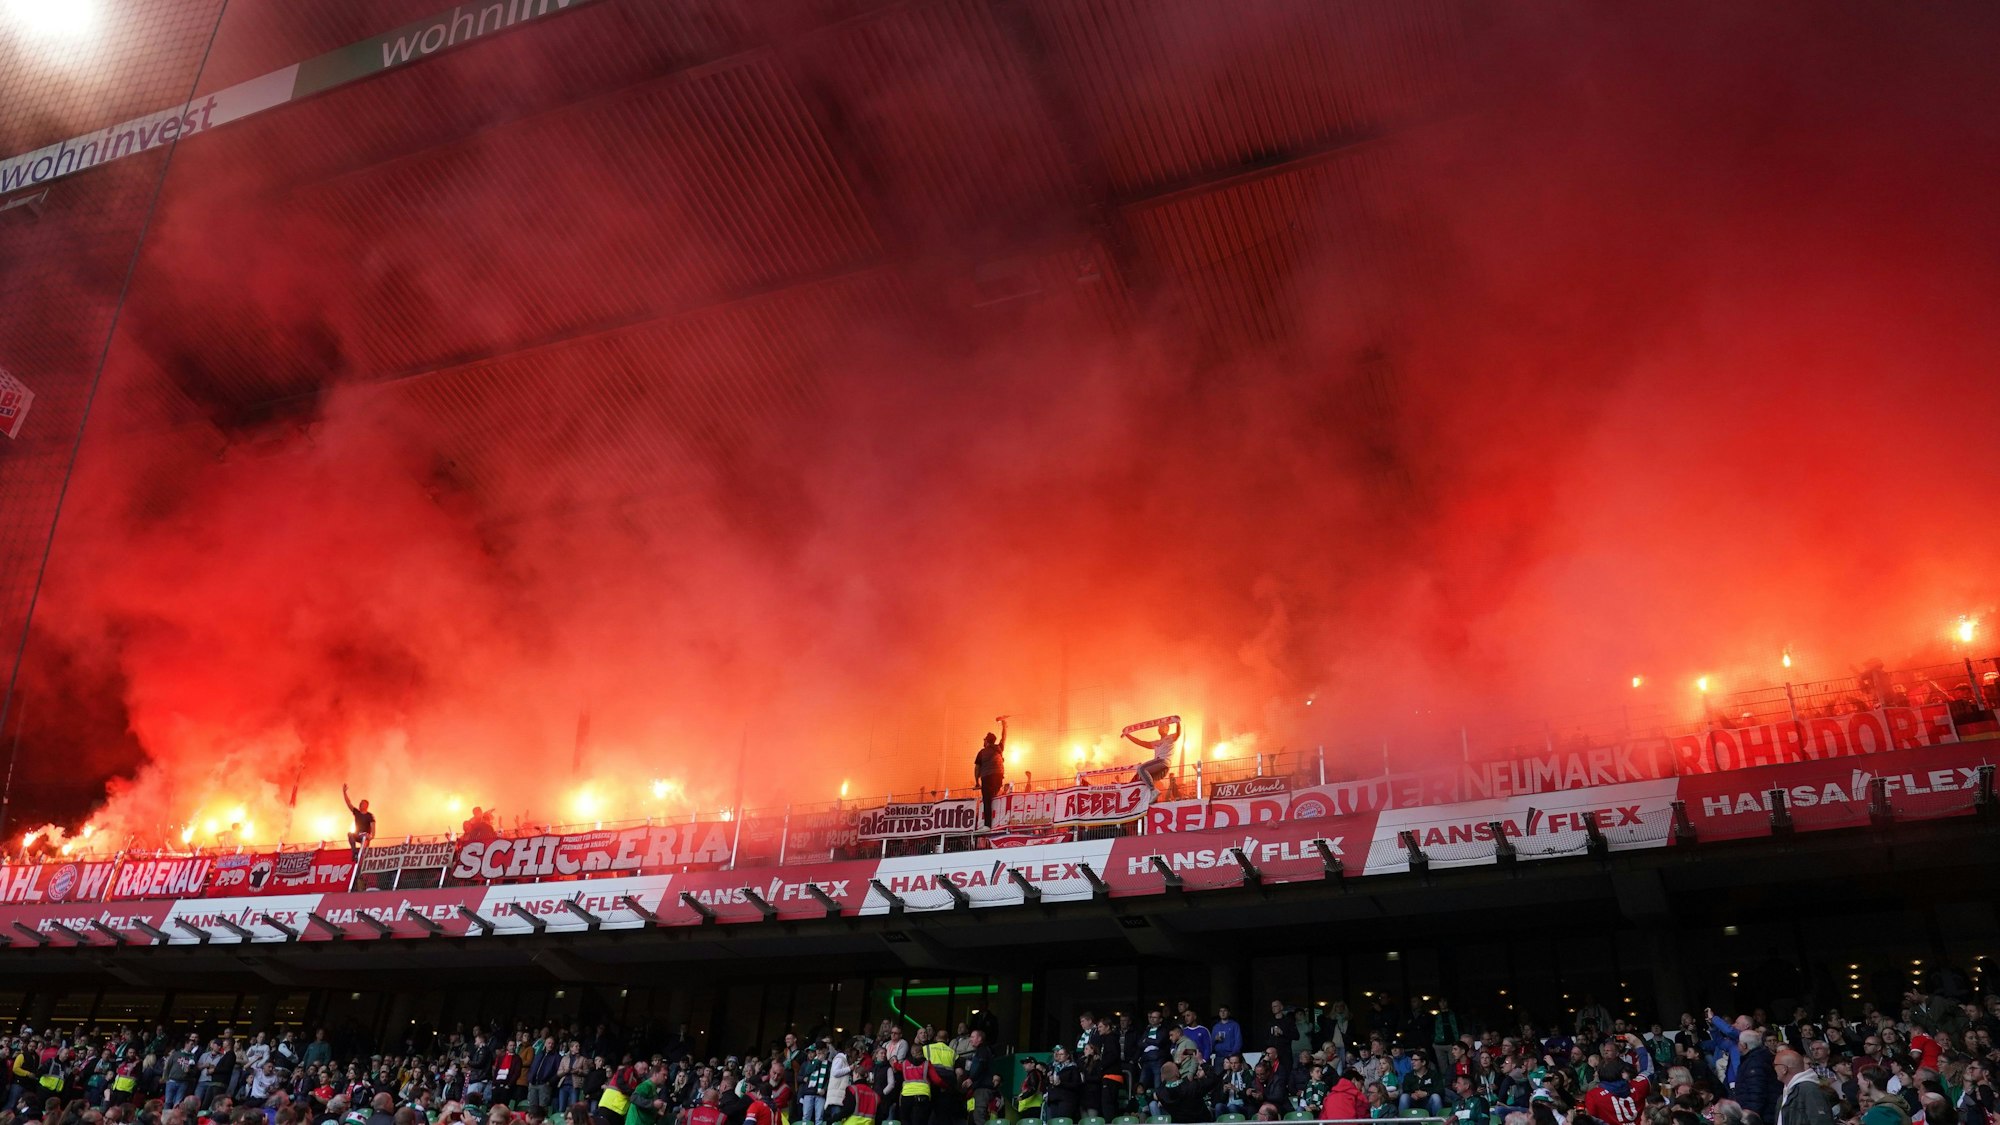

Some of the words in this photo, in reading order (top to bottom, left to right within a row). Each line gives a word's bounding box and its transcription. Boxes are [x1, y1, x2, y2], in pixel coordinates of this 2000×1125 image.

[1, 96, 218, 192] wohninvest
[1673, 704, 1954, 776] ROHRDORF
[1244, 779, 1285, 795] Casuals
[1463, 744, 1666, 798] NEUMARKT
[884, 805, 919, 816] Sektion
[921, 804, 934, 815] SV
[1064, 787, 1142, 818] REBELS
[1147, 802, 1240, 835] RED
[362, 857, 400, 871] IMMER
[402, 855, 423, 867] BEI
[426, 854, 450, 866] UNS
[364, 842, 454, 858] AUSGESPERRTE
[452, 822, 733, 879] SCHICKERIA
[114, 860, 211, 896] RABENAU
[1610, 1095, 1638, 1123] 10
